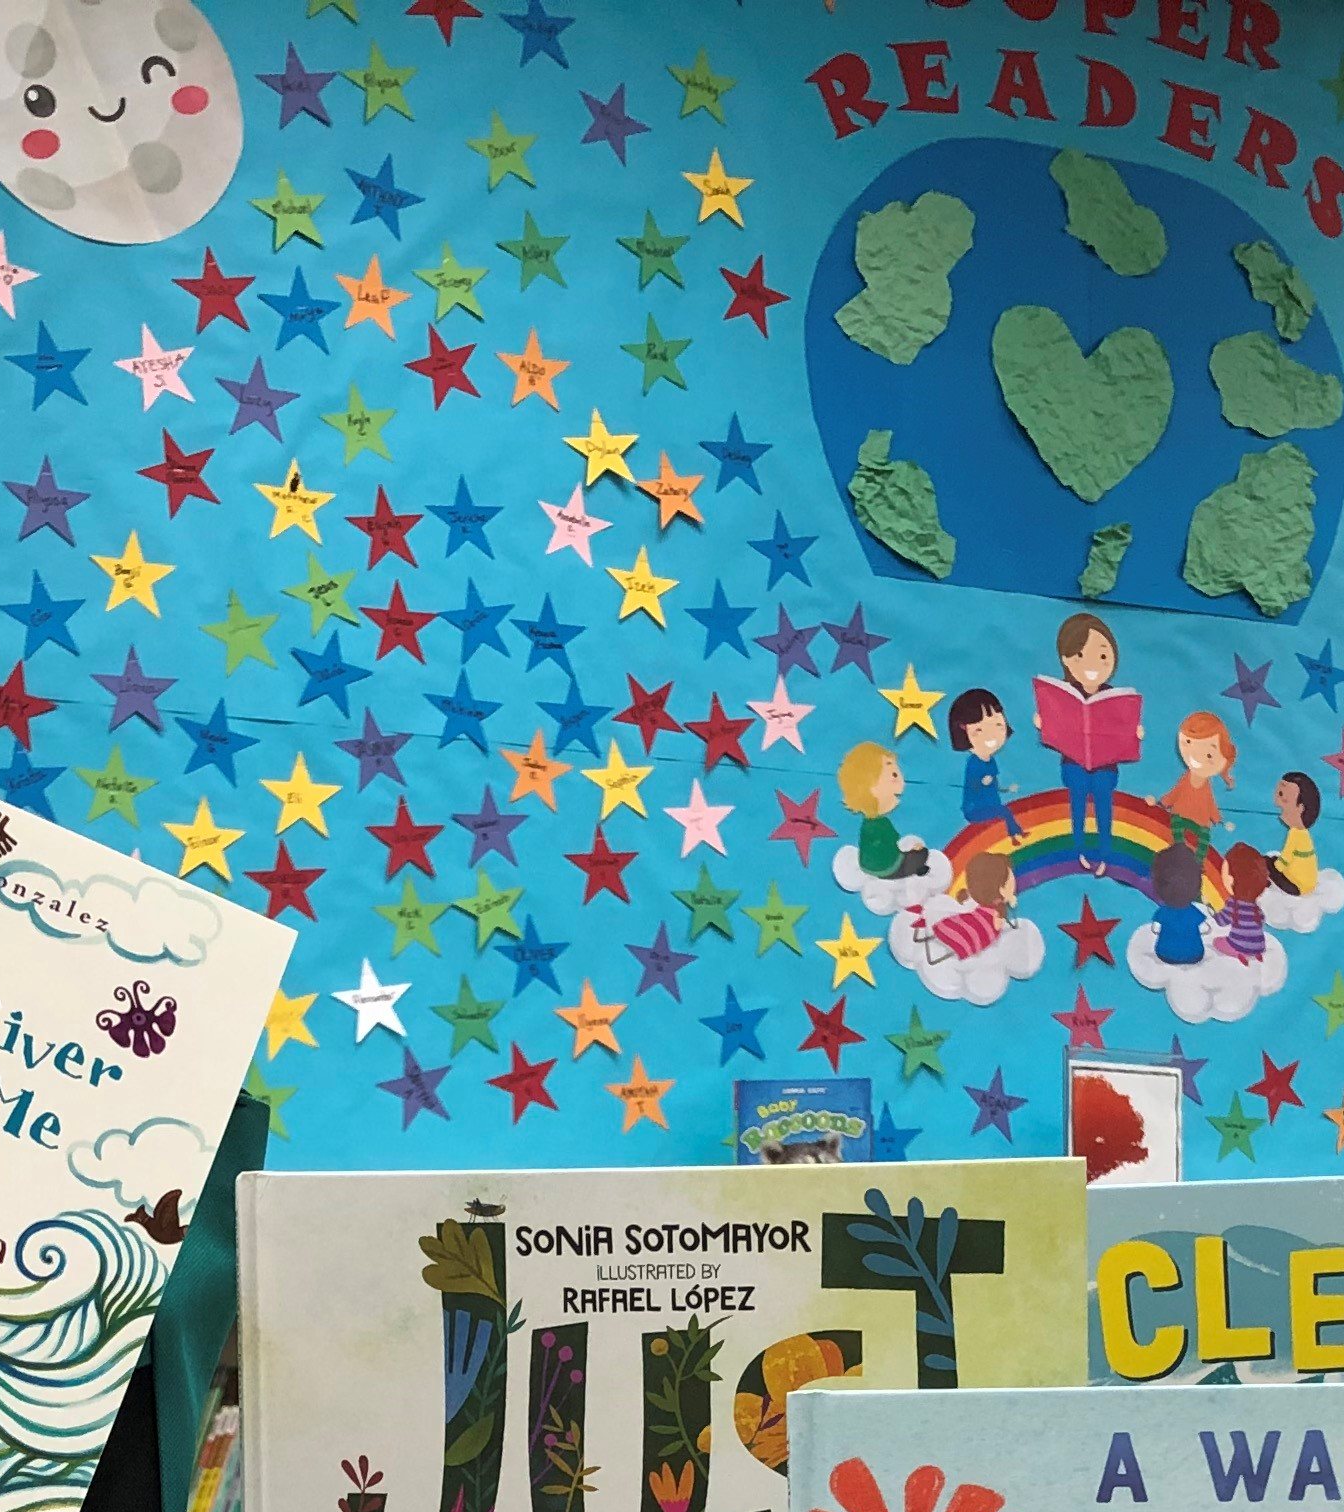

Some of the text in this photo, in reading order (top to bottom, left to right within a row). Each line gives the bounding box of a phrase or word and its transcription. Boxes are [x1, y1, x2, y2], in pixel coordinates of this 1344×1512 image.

[701, 1263, 721, 1280] BY
[562, 1284, 756, 1314] RAFAEL LÓPEZ
[1096, 1431, 1150, 1506] A
